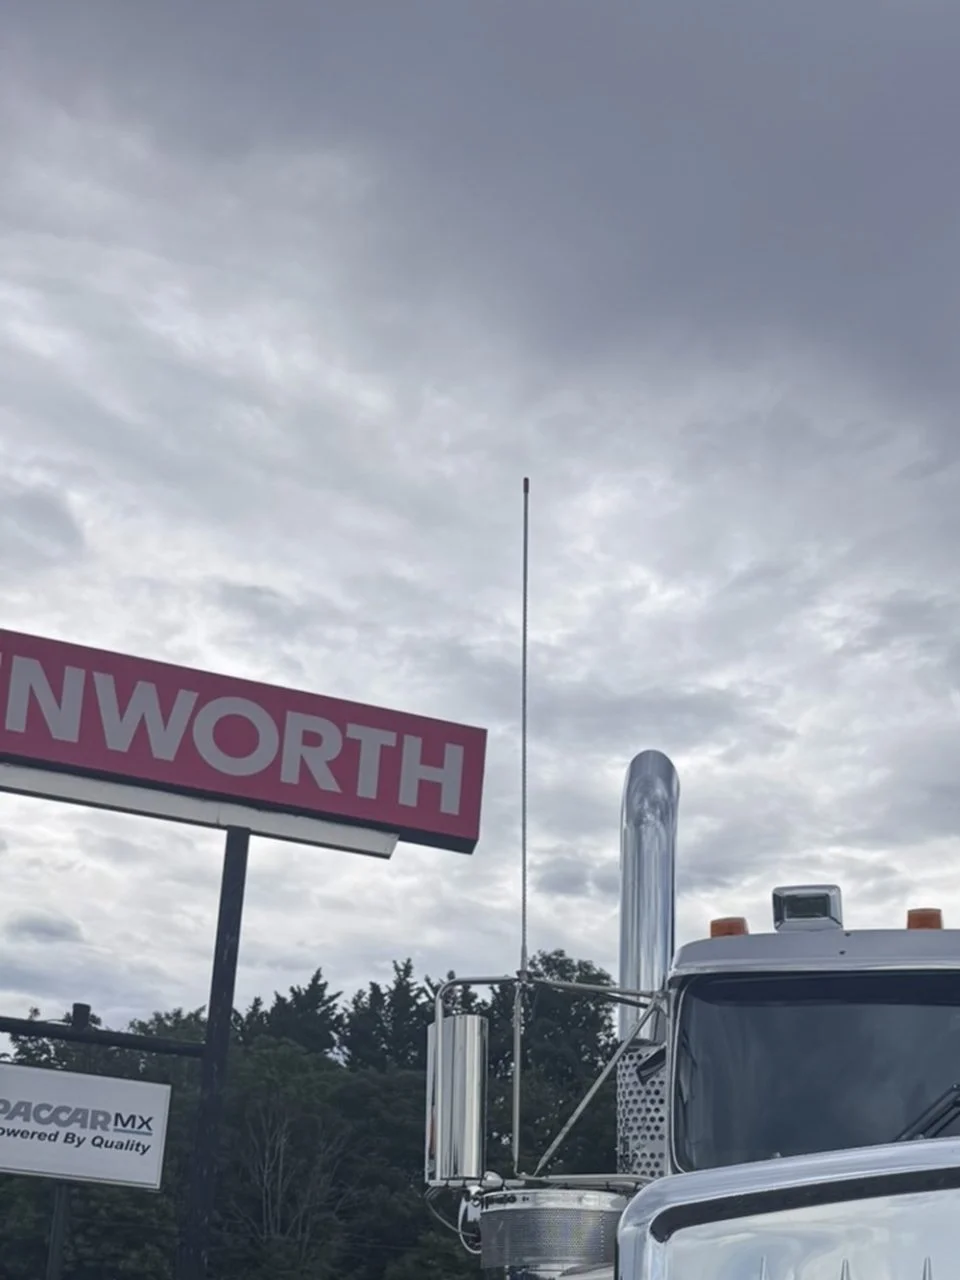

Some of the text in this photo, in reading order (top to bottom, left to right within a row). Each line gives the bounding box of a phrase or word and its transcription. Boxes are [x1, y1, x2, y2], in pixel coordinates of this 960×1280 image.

[0, 652, 465, 816] NWORTH
[63, 1131, 87, 1149] By
[91, 1135, 152, 1157] Quality
